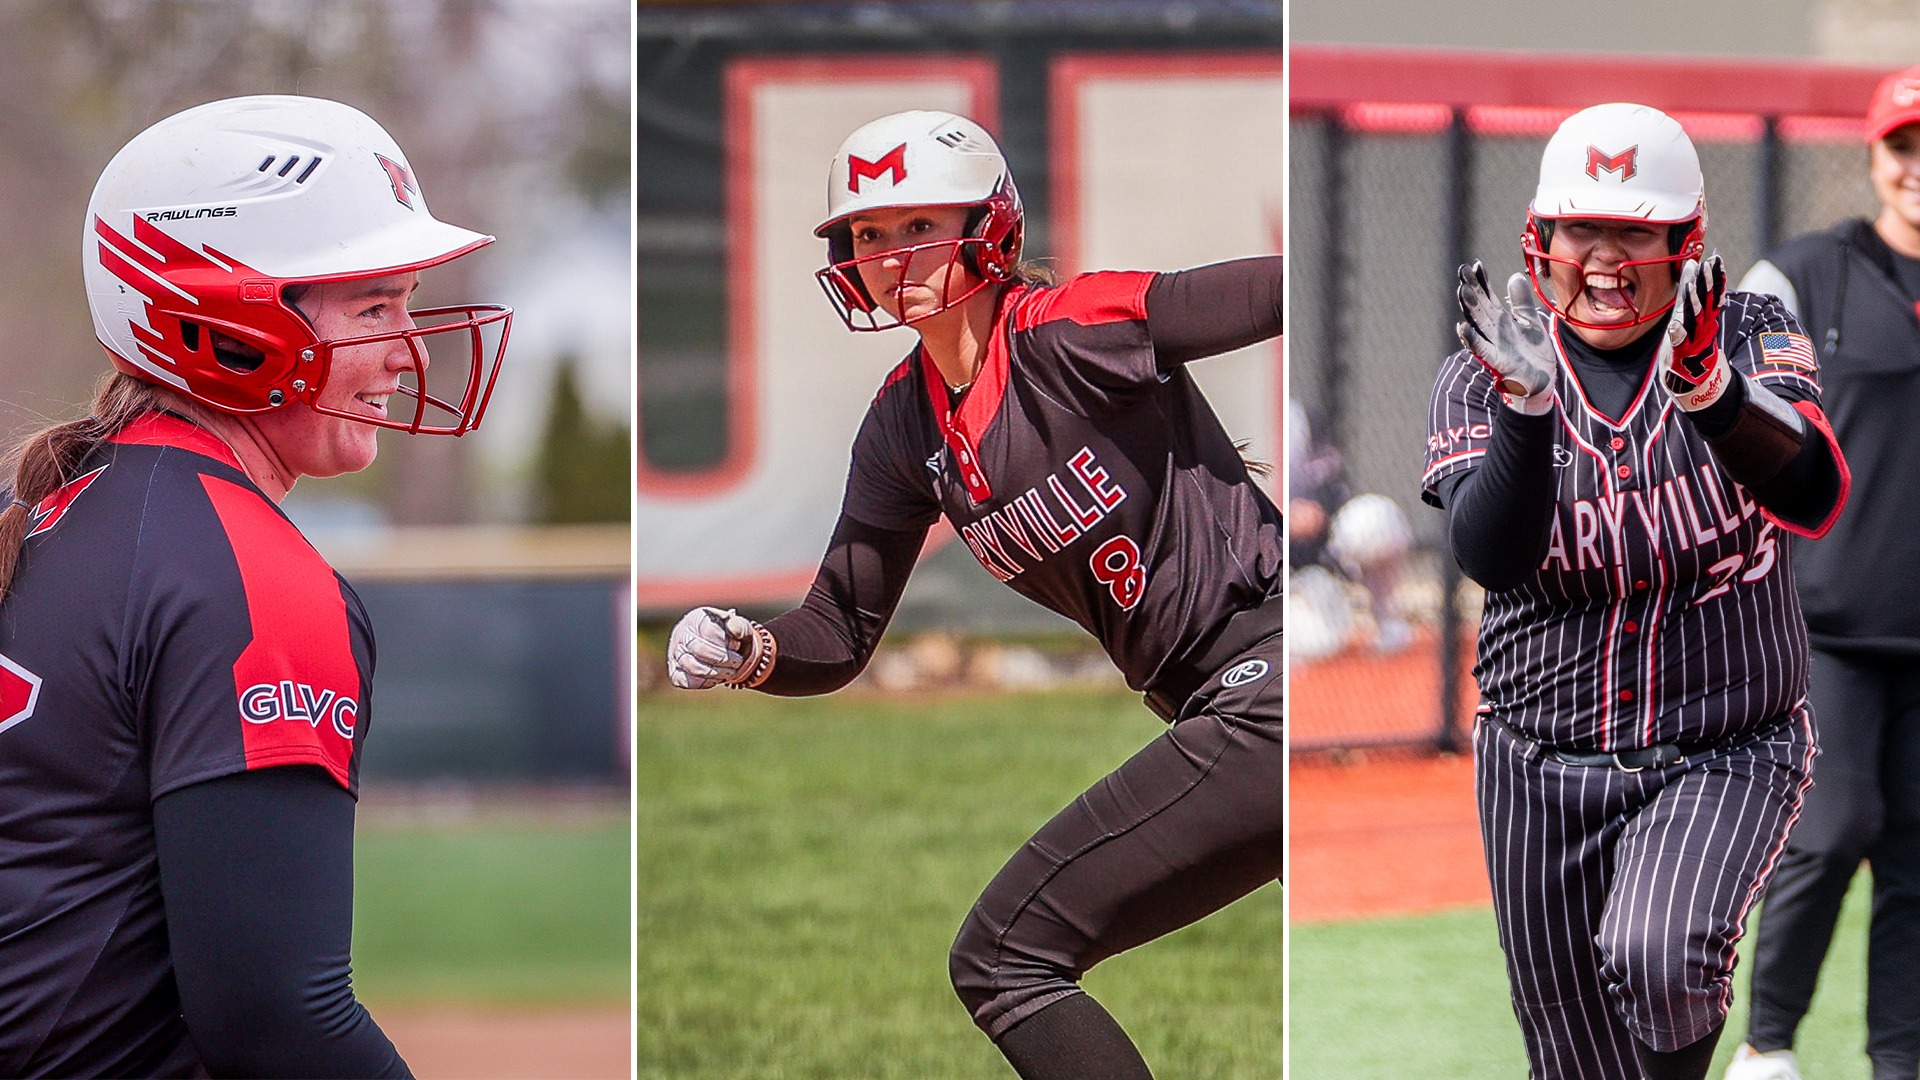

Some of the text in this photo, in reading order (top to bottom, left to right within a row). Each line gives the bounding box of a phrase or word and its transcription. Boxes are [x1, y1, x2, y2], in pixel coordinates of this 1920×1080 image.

[847, 141, 908, 195] M
[1585, 143, 1638, 183] M
[146, 206, 238, 222] RAWLINGS
[1089, 534, 1147, 612] 8
[1693, 521, 1776, 606] 25
[239, 680, 359, 740] GLVC
